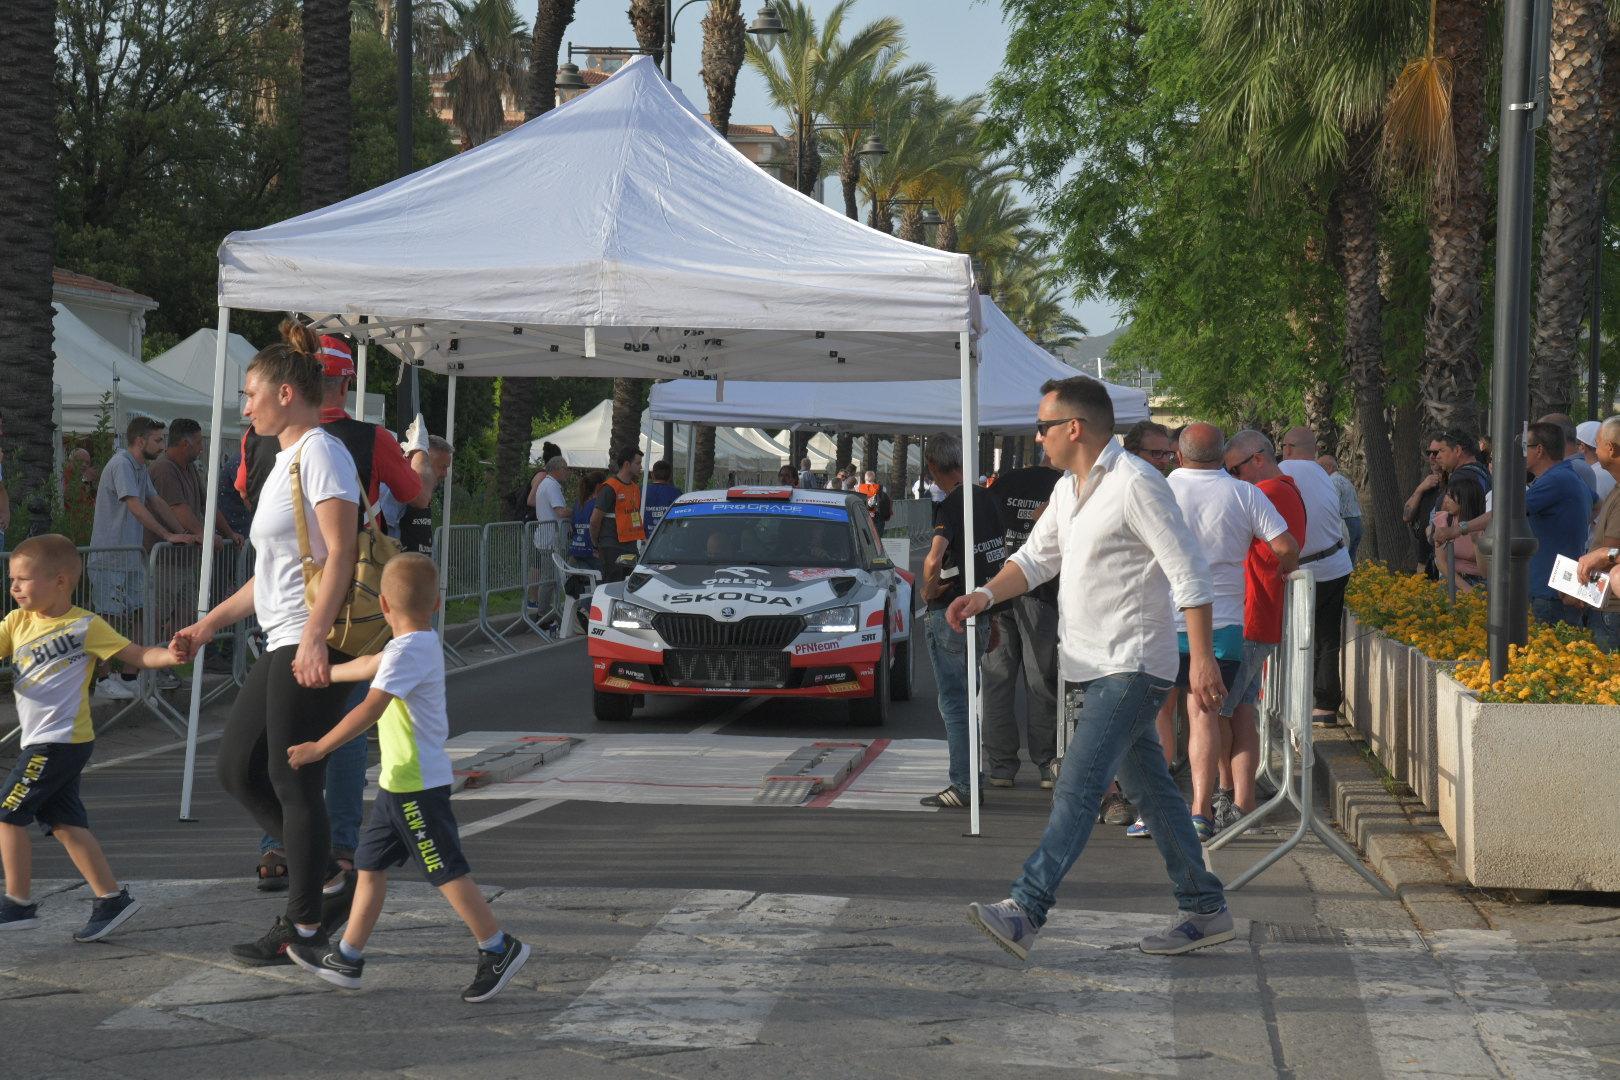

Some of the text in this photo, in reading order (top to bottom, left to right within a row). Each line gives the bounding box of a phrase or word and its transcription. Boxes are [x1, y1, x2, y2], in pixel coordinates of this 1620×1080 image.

[1006, 497, 1044, 508] SCRUTIN
[702, 578, 772, 587] ORLEN
[670, 592, 792, 607] ŠKODA
[591, 627, 606, 637] SRT
[861, 633, 877, 643] SRT
[32, 633, 81, 664] BLUE
[795, 640, 840, 655] PFNteam
[1, 754, 48, 812] NEW BLUE
[402, 800, 444, 873] NEW BLUE
